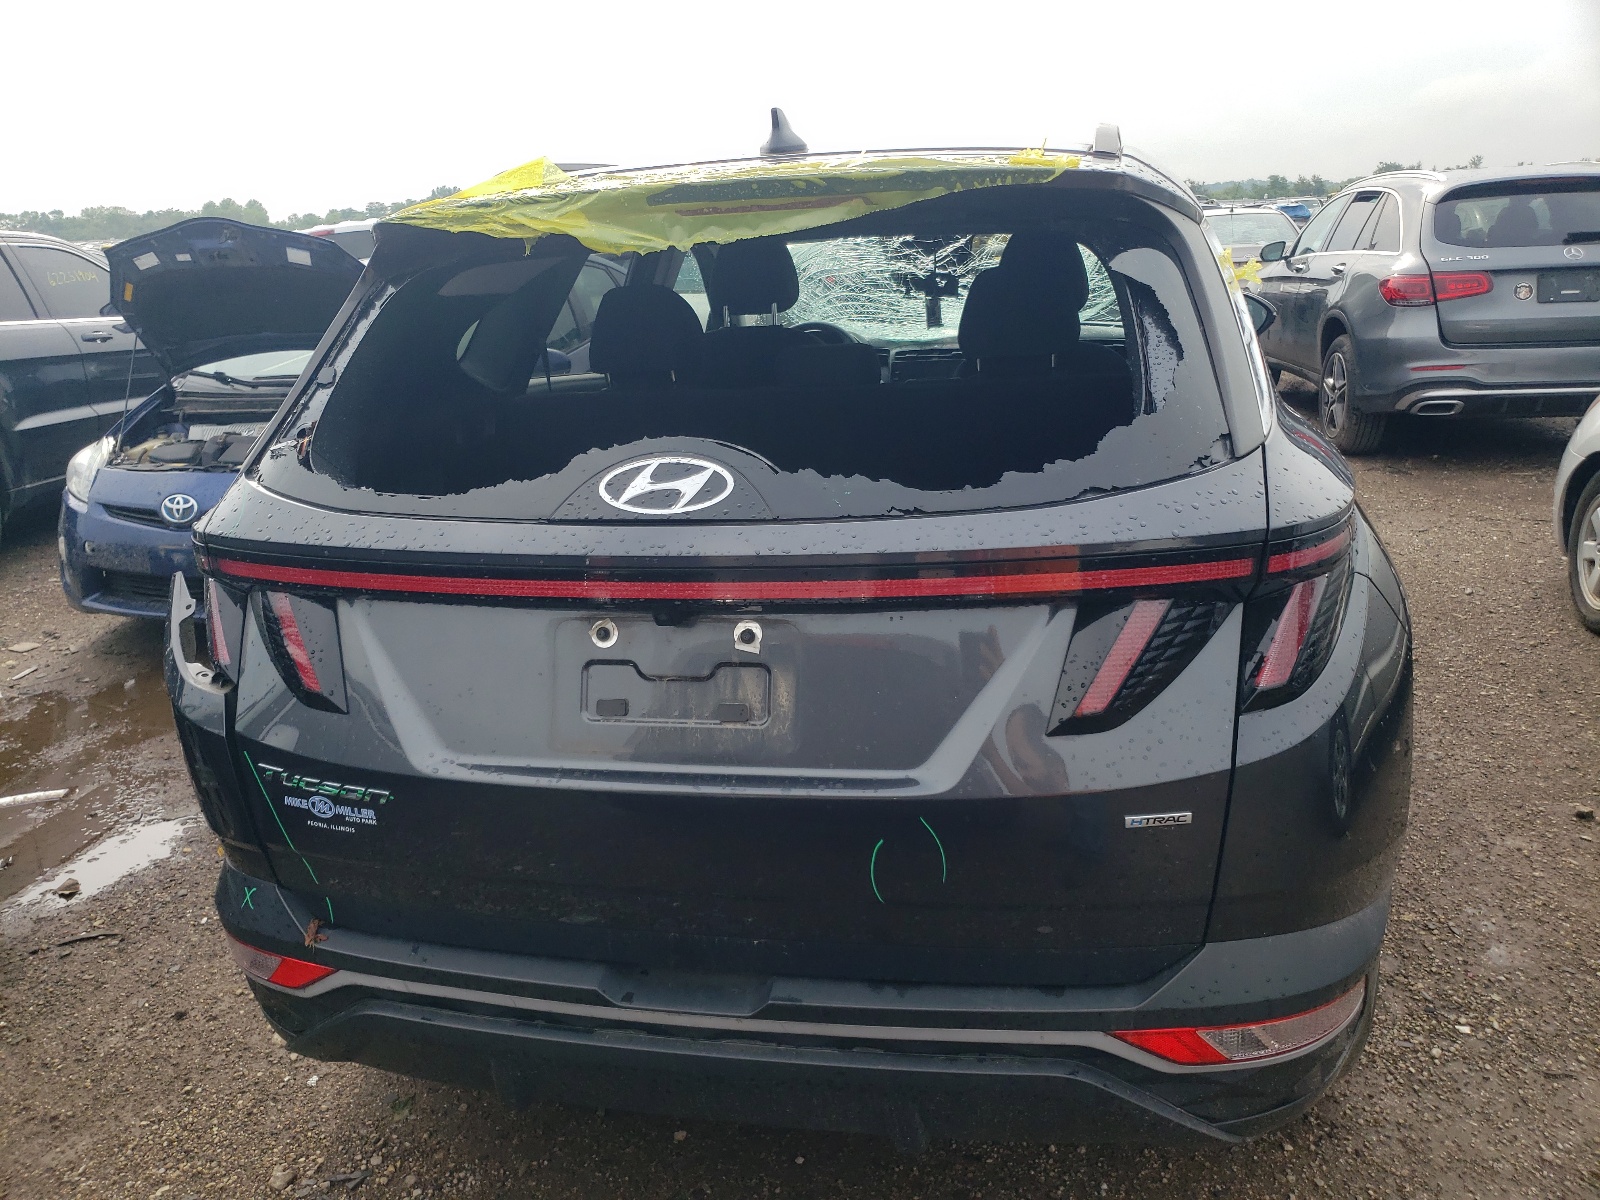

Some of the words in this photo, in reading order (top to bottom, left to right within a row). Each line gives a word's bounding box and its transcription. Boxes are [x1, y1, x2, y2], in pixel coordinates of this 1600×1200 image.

[284, 795, 309, 809] MIKE
[335, 804, 376, 819] MILLER
[345, 816, 361, 824] AUTO
[361, 818, 377, 826] PARK
[1130, 815, 1188, 826] HTRAC
[330, 823, 356, 833] ILLINOIS
